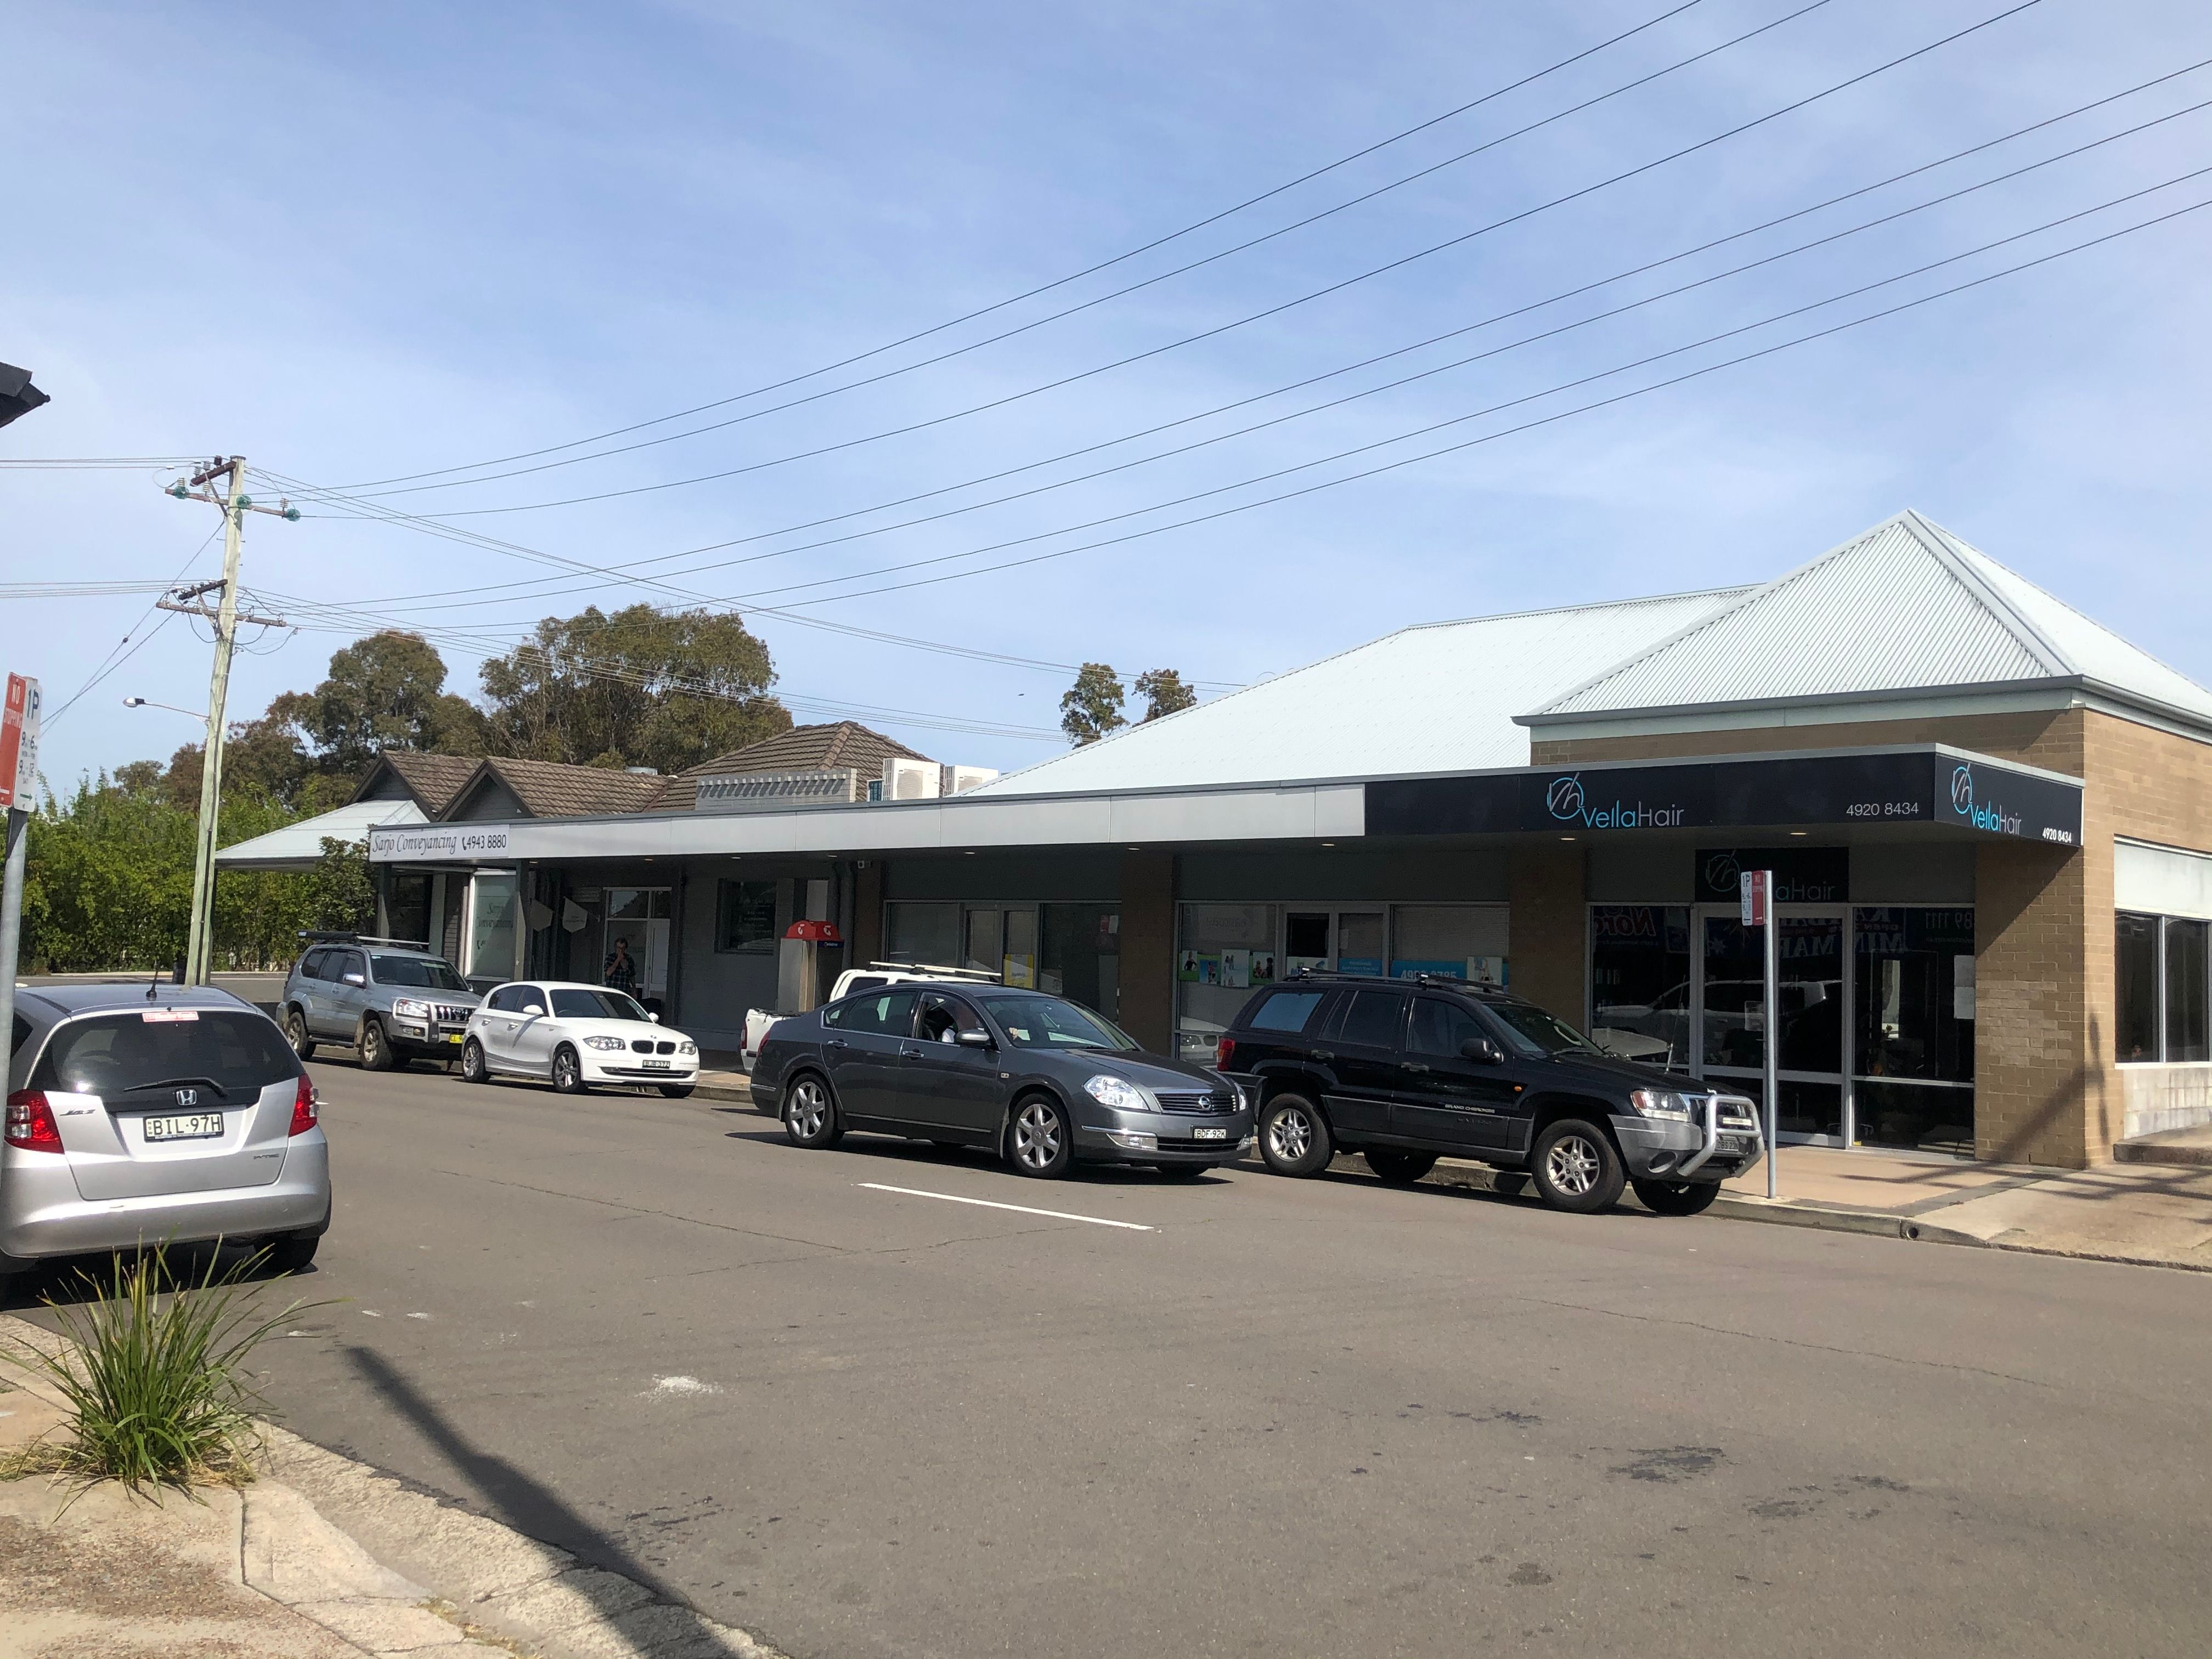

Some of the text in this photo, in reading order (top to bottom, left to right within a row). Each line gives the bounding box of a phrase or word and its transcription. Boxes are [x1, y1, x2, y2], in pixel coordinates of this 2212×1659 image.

[12, 684, 21, 704] NO
[27, 689, 40, 720] 1P
[1846, 802, 1919, 816] 4920 8434
[373, 831, 506, 856] Sarjo Conveyancing 4943 8880
[2042, 827, 2072, 844] 4920 8434
[1742, 873, 1750, 887] 1P
